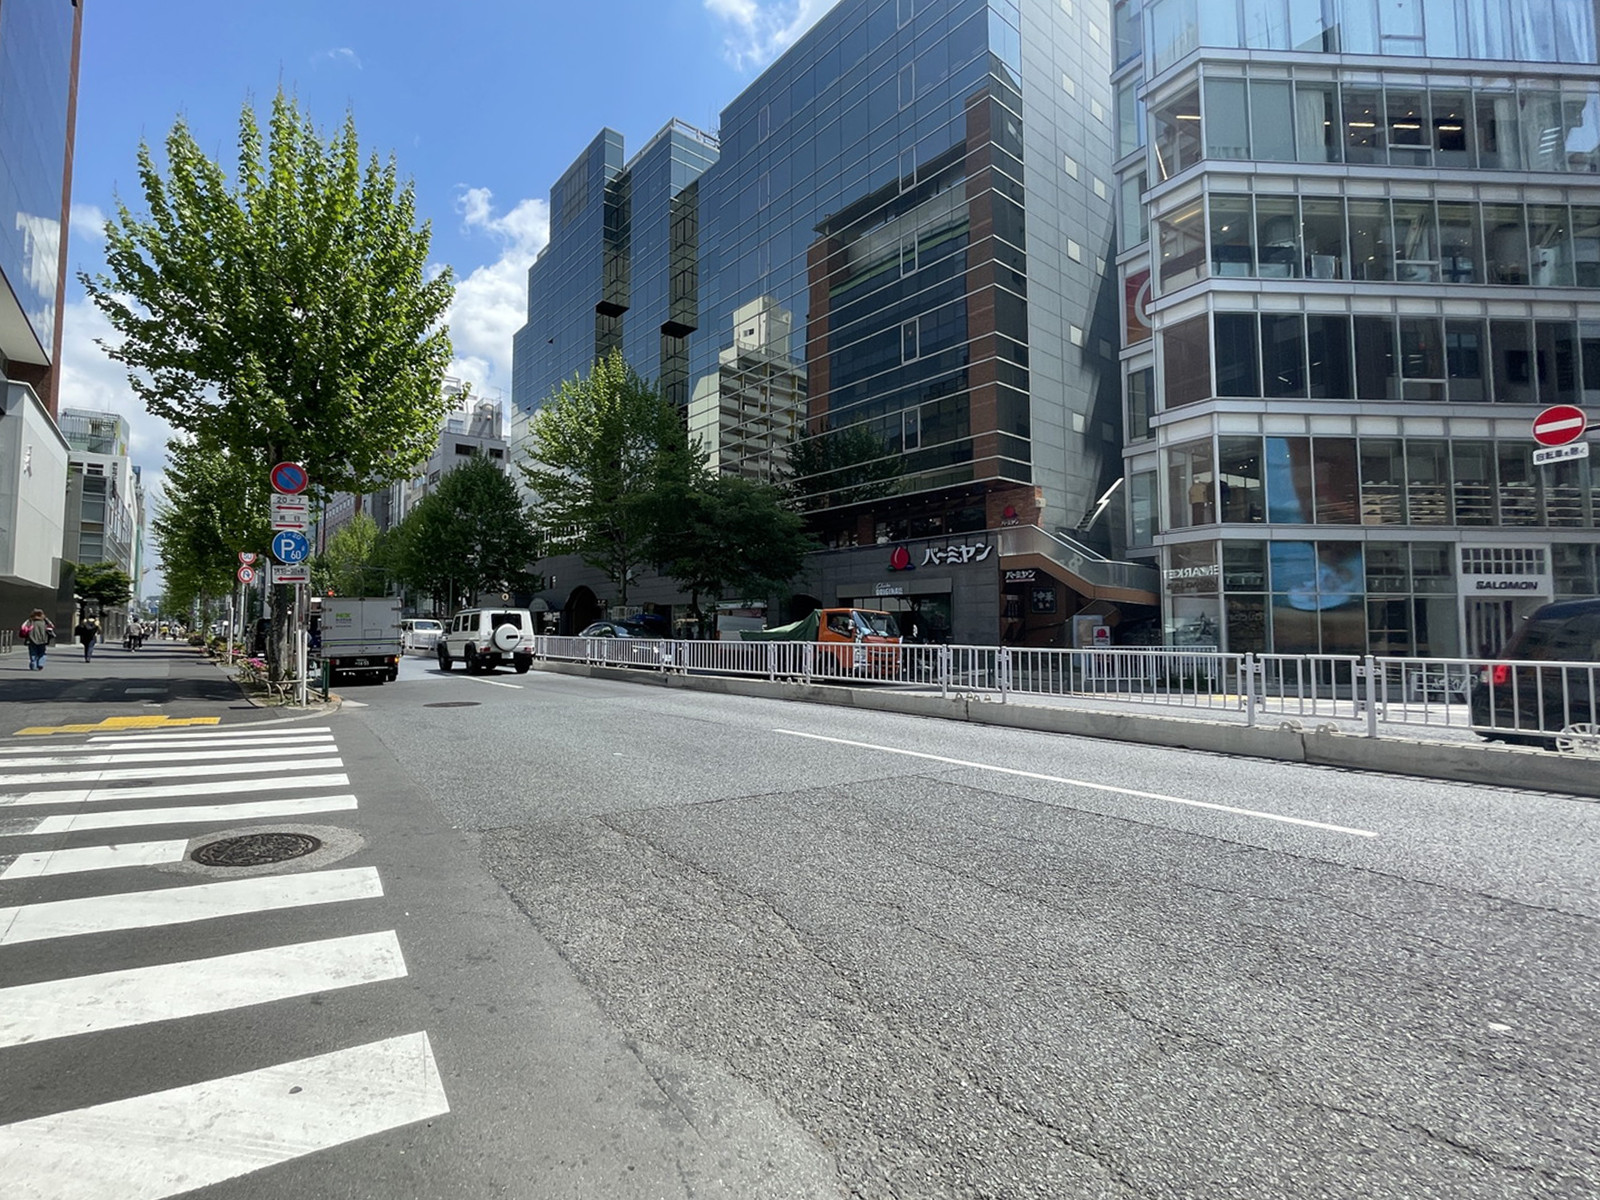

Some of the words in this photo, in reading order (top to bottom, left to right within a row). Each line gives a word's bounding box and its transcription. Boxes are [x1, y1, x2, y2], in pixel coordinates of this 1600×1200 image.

[920, 542, 993, 566] バーミヤン
[1005, 569, 1036, 580] バーミヤン
[1475, 580, 1539, 590] SALOMON
